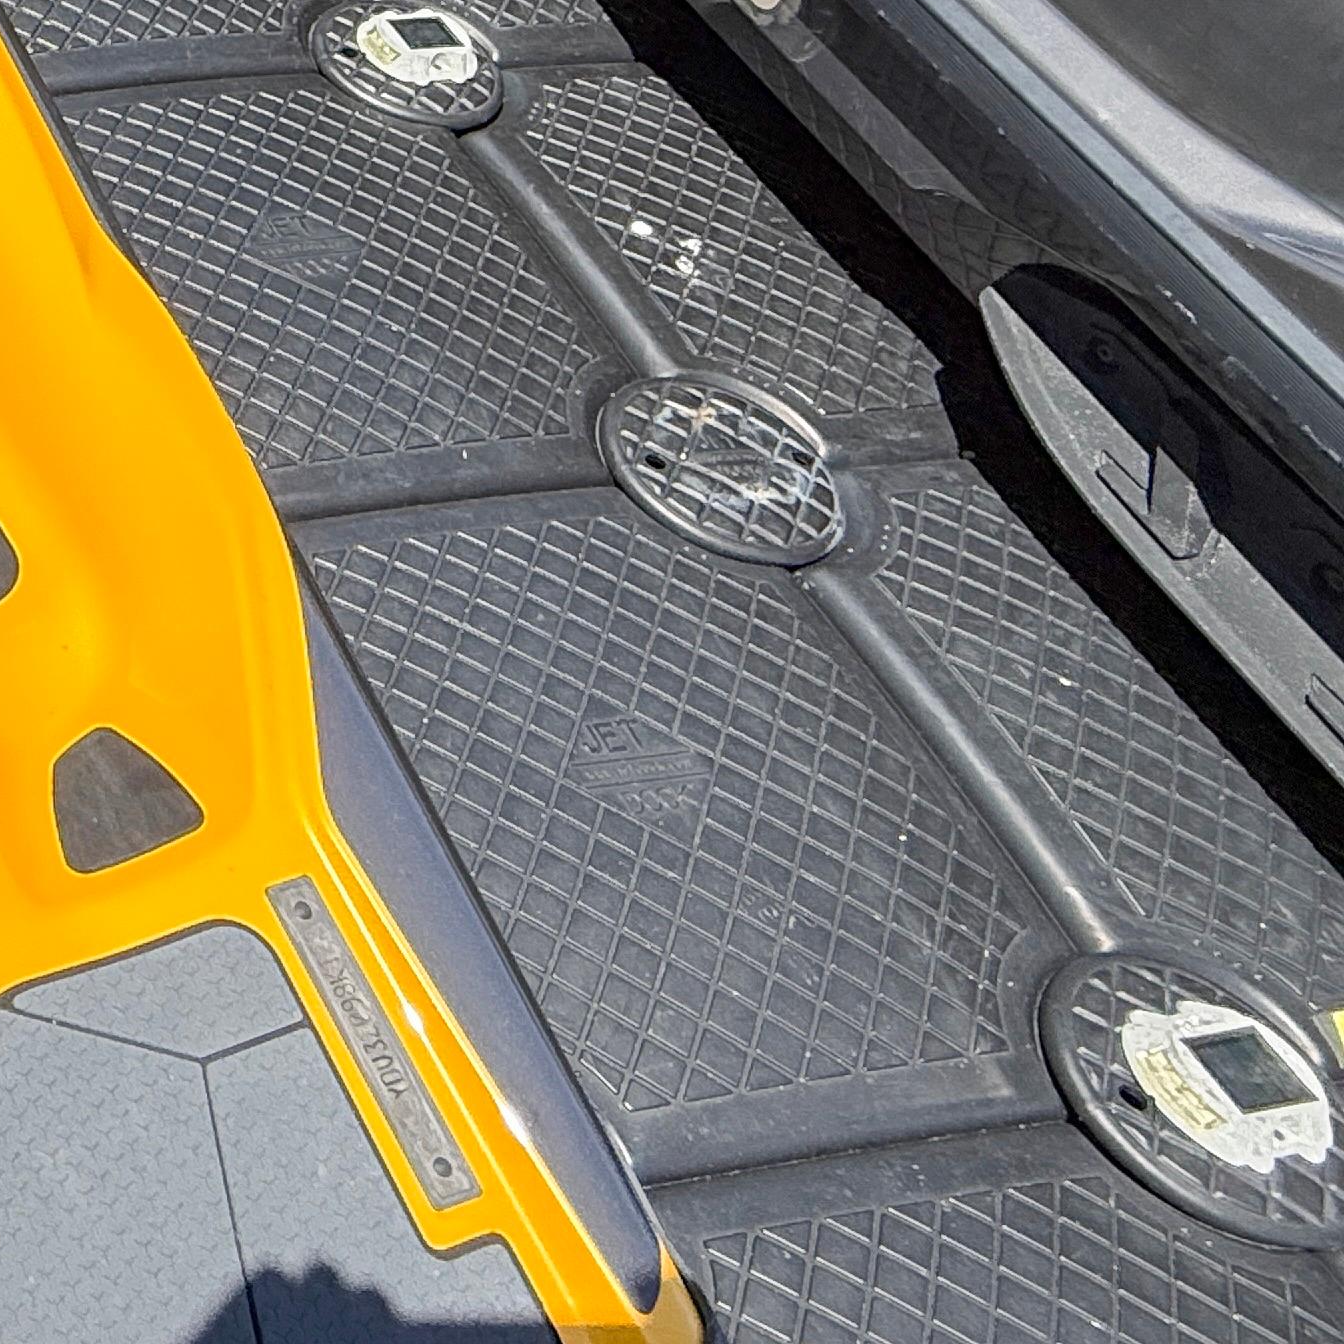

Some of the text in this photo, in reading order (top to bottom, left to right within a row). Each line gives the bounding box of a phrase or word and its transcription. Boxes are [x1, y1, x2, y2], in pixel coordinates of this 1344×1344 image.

[260, 216, 312, 239] JET
[582, 718, 643, 753] JET
[618, 782, 701, 814] DOCK
